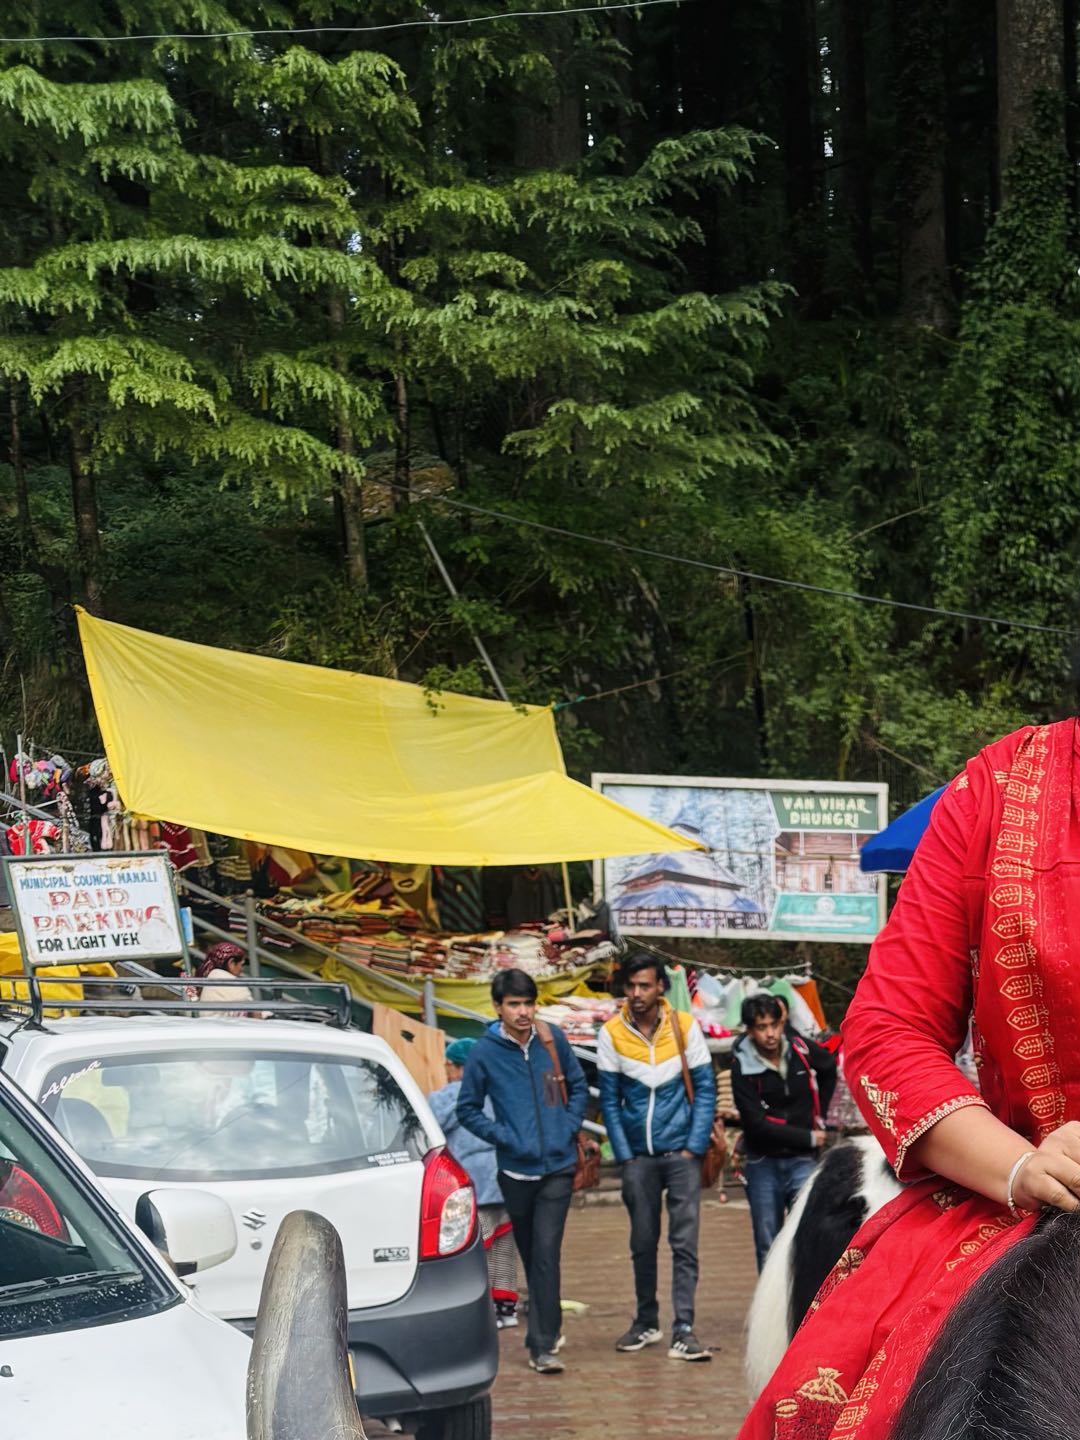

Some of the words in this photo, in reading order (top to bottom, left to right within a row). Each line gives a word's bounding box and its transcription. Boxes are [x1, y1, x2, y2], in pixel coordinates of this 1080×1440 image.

[782, 796, 815, 810] VAN
[819, 797, 872, 814] VIHAR
[789, 811, 859, 829] DHUNGRI
[19, 875, 71, 890] MUNICIPAL
[73, 873, 115, 887] COUNCIL
[118, 871, 158, 884] MANALI
[48, 887, 129, 910] PAID
[37, 938, 64, 953] FOR
[67, 934, 107, 950] LIGHT
[375, 1248, 409, 1258] ALTO
